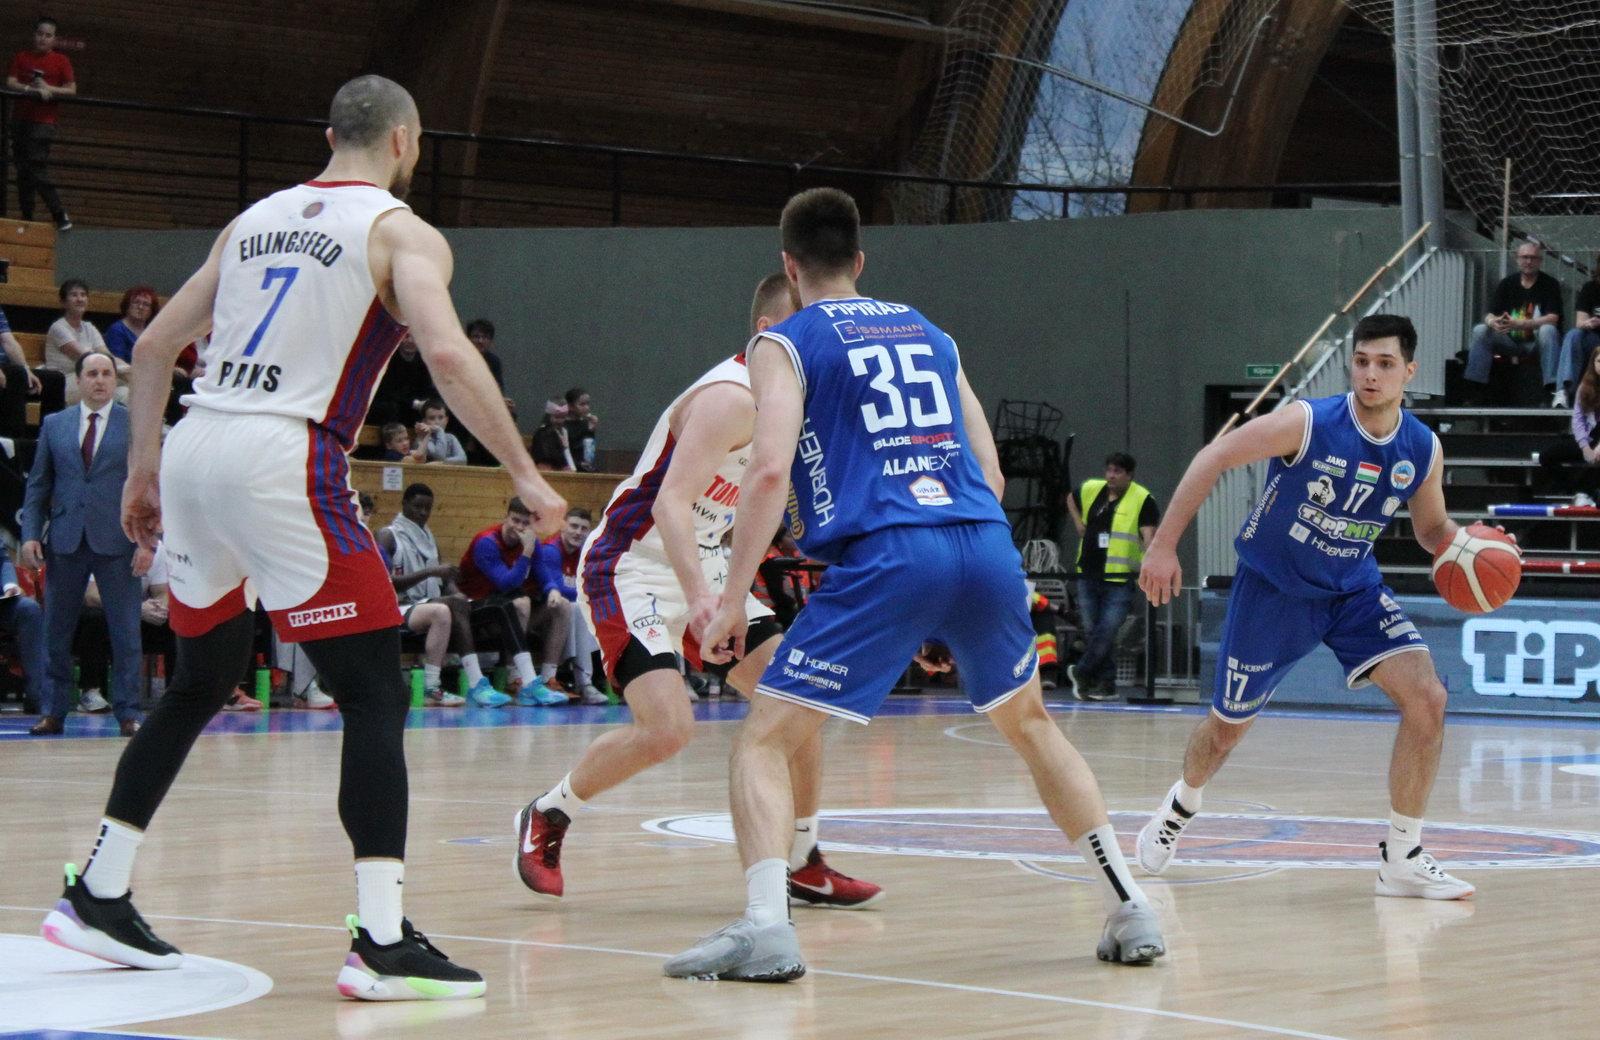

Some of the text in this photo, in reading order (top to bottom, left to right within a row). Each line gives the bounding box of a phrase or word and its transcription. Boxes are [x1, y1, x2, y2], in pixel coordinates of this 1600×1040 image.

[239, 230, 343, 268] EILINGSFELD
[241, 266, 300, 357] 7
[845, 324, 923, 335] EISSMANN
[847, 343, 953, 434] 35
[882, 452, 952, 476] ALANEX
[1325, 455, 1347, 468] JAKO
[1342, 482, 1375, 514] 17
[1225, 669, 1249, 702] 17
